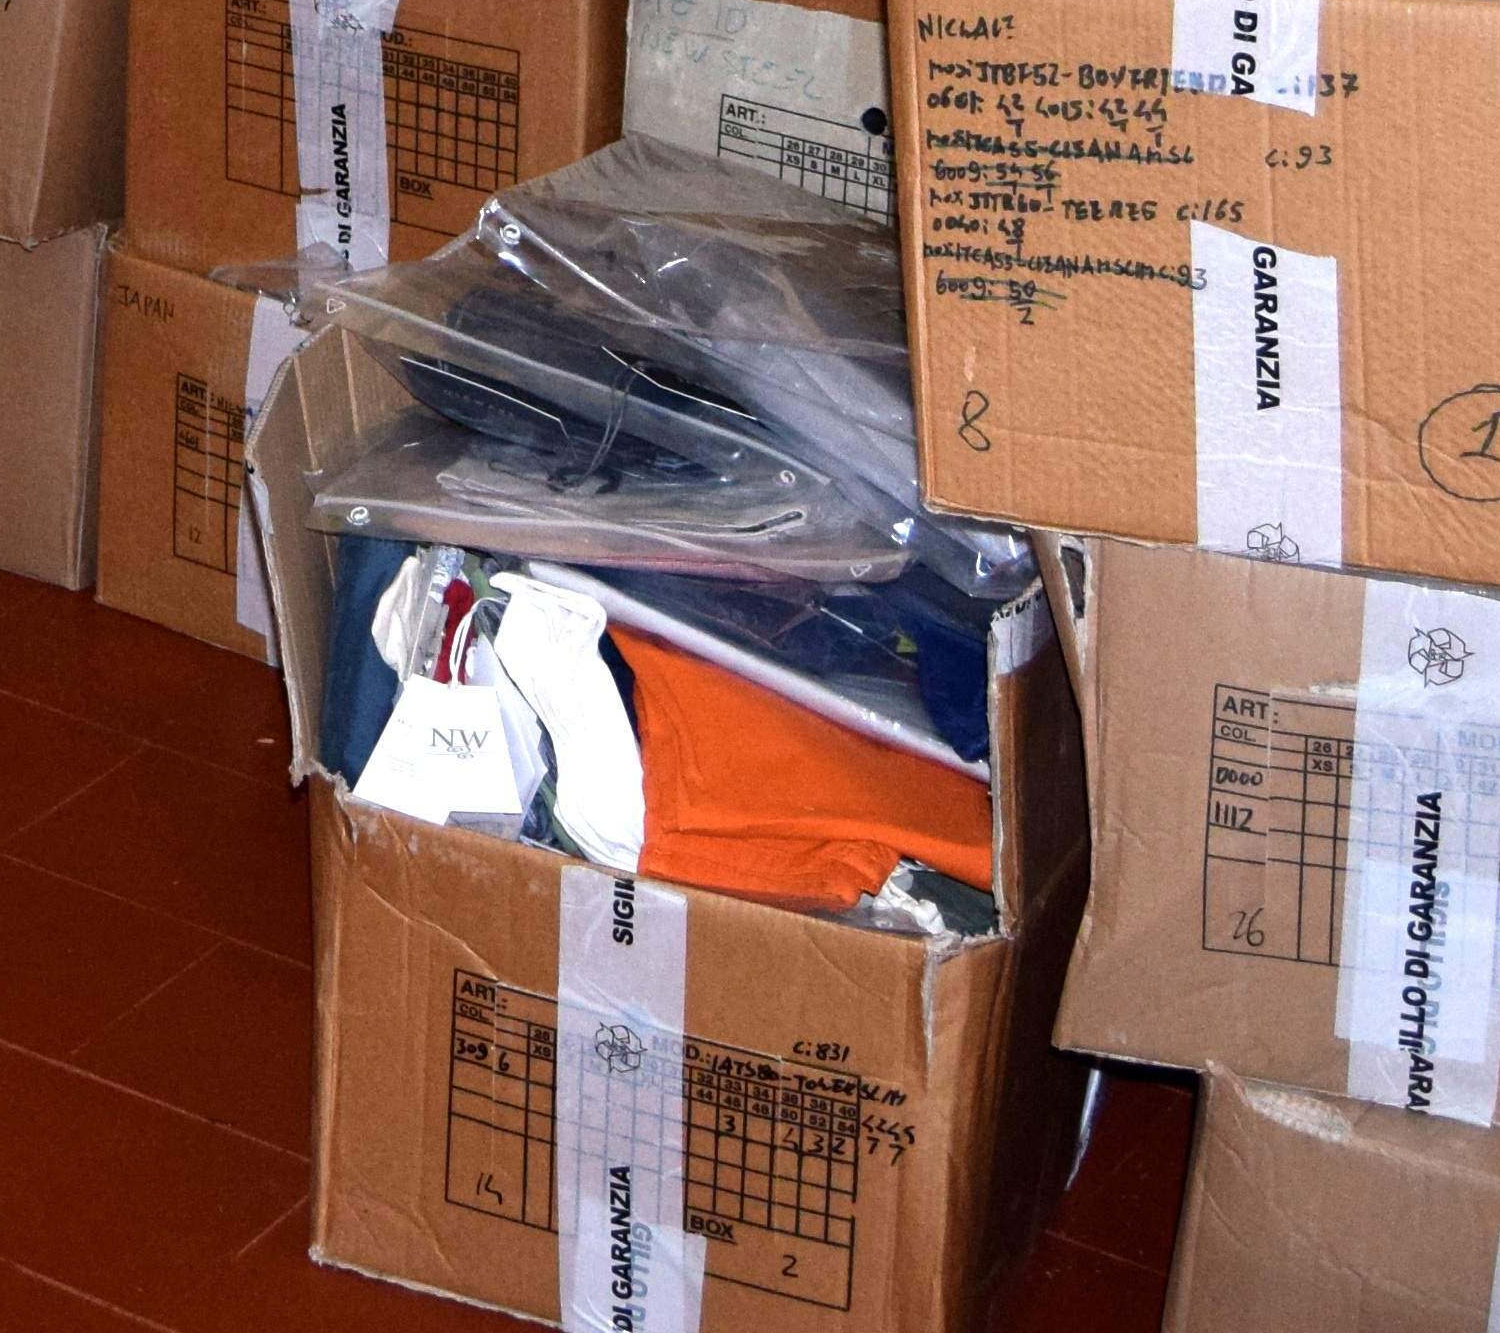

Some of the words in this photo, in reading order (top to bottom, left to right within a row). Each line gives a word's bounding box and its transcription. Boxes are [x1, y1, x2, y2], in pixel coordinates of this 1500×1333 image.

[1233, 8, 1258, 43] DI
[332, 103, 351, 218] GARANZIA
[399, 176, 432, 195] BOX
[337, 221, 352, 245] DI
[116, 285, 175, 318] JAPAN
[1252, 244, 1281, 412] GARANZIA
[958, 390, 991, 452] 8
[430, 727, 492, 750] NW
[1407, 790, 1443, 941] GARANZIA
[1229, 907, 1266, 949] 26
[1404, 944, 1432, 980] DI
[723, 1114, 736, 1134] 3
[609, 1166, 631, 1300] GARANZIA
[690, 1214, 735, 1240] BOX
[781, 1254, 799, 1278] 2
